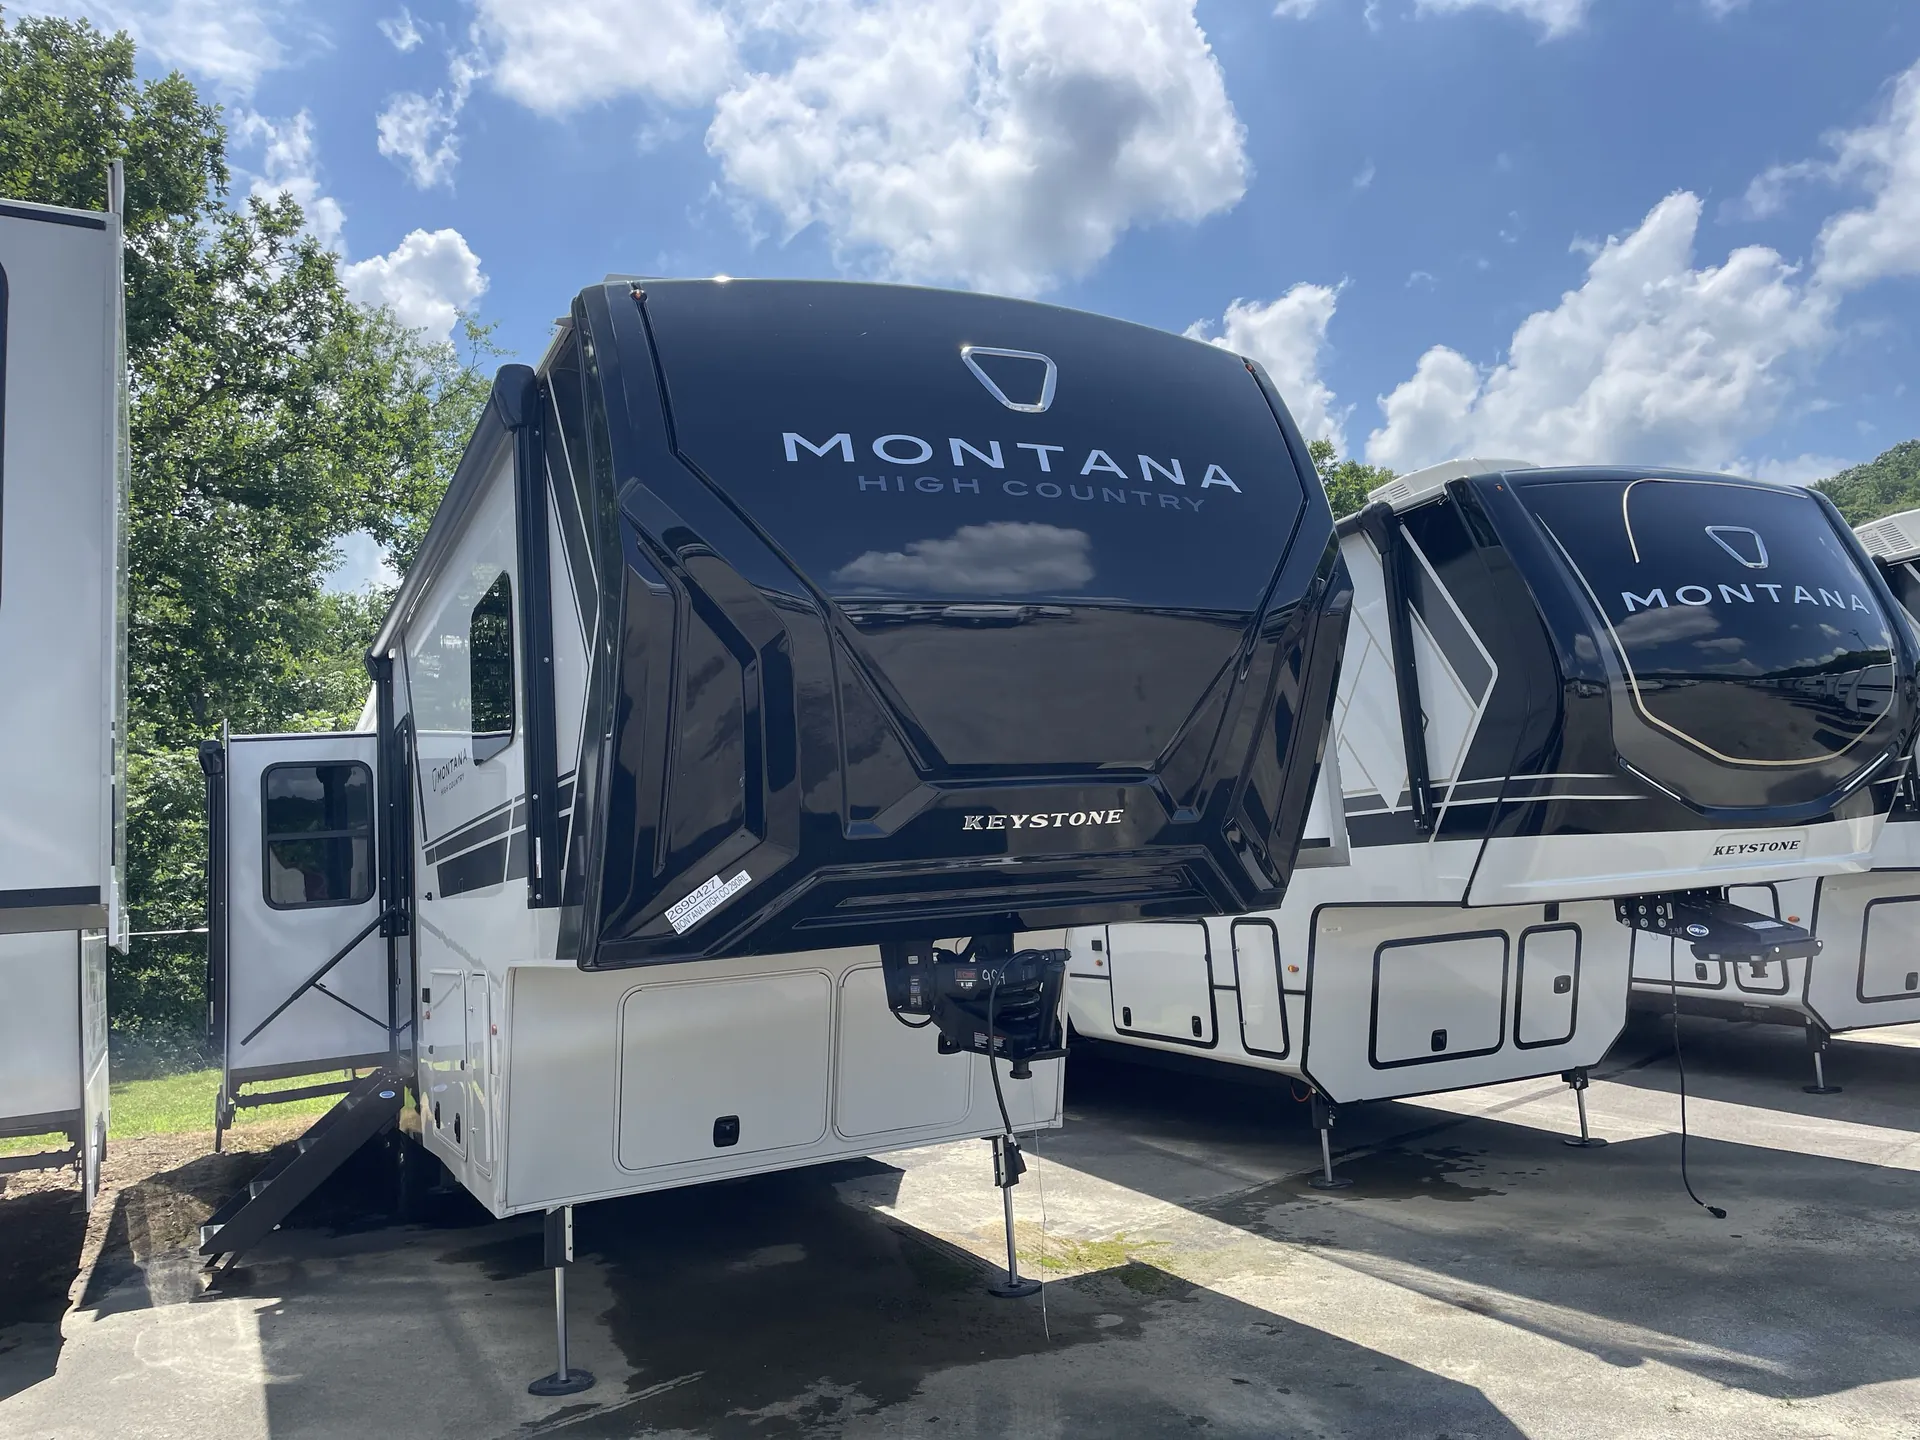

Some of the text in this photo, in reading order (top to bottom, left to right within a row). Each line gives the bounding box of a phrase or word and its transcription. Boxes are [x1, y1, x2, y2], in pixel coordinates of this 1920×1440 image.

[781, 432, 1242, 493] MONTANA
[857, 475, 1205, 513] HIGH COUNTRY
[1621, 583, 1871, 615] MONTANA
[437, 748, 468, 783] MONTANA
[962, 809, 1124, 830] KEYSTONE
[1713, 840, 1801, 856] KEYSTONE
[667, 879, 716, 921] 2690427
[673, 874, 749, 932] MONTANA HIGH CO 290RL
